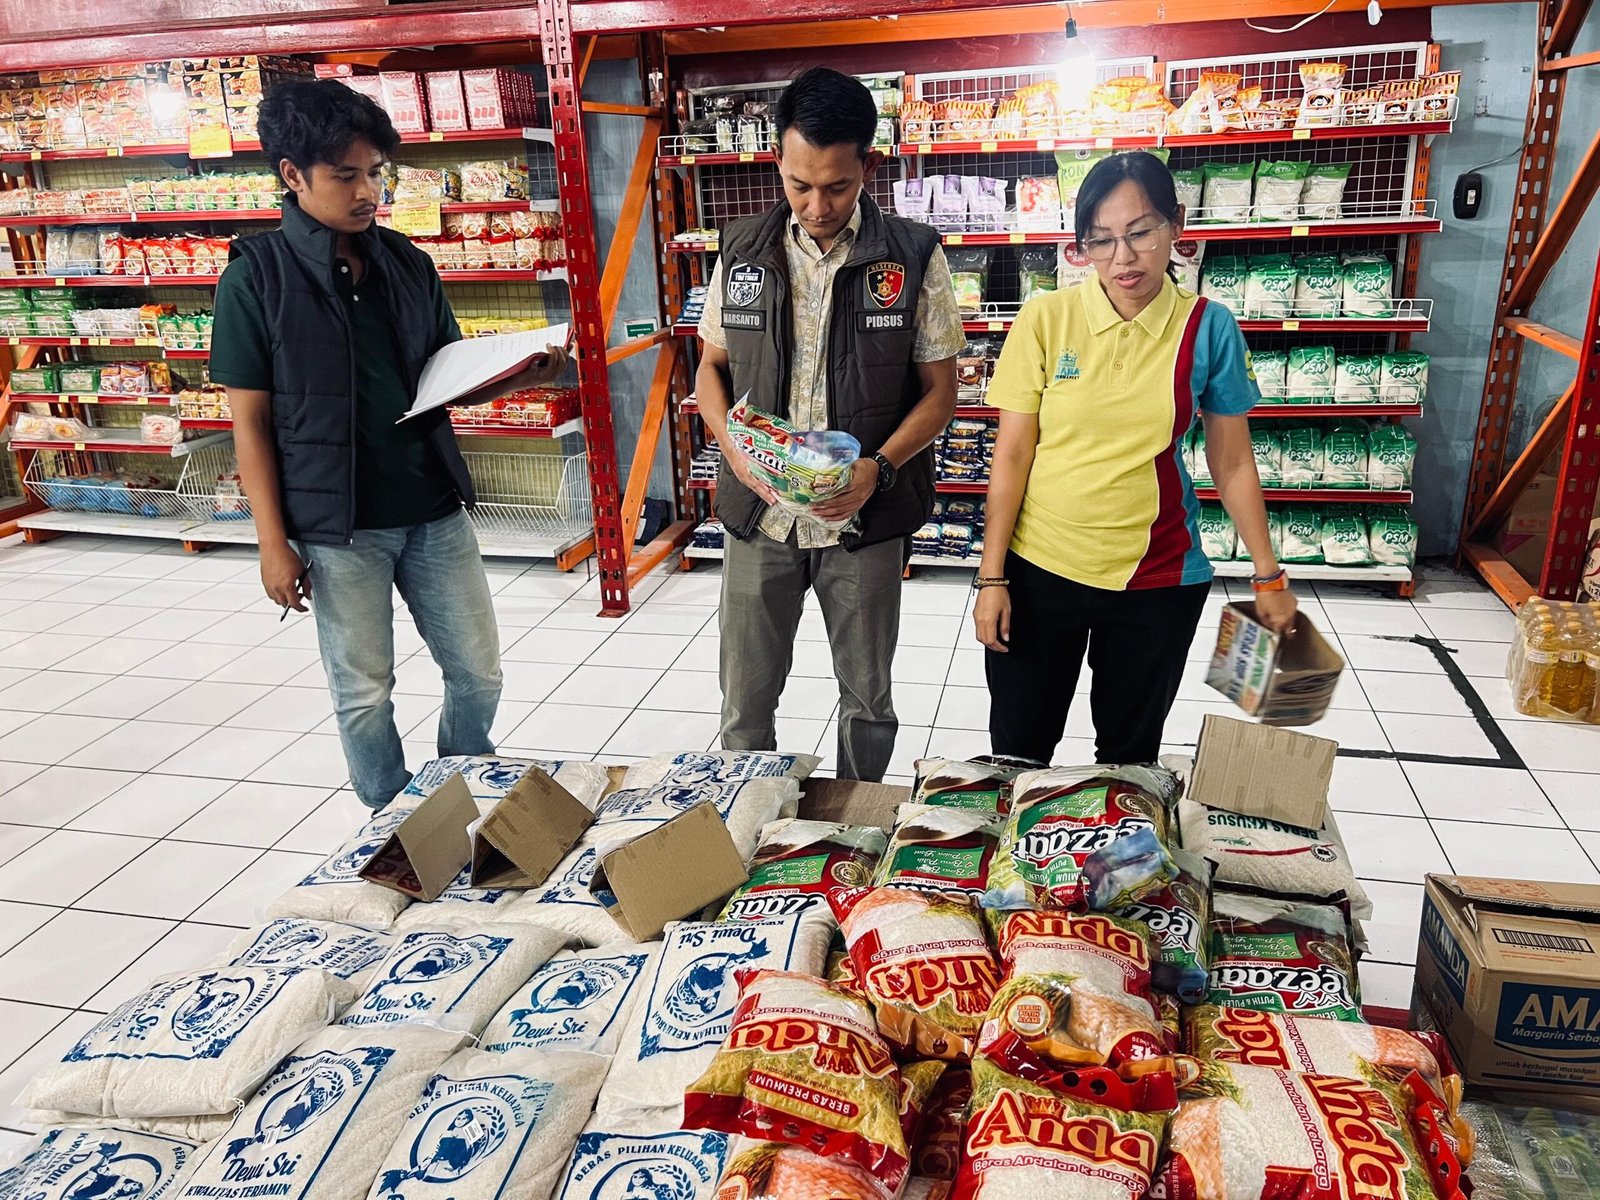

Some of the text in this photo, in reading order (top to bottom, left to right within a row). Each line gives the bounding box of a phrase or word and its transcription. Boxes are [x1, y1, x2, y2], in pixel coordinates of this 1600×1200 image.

[1212, 276, 1238, 287] PSM
[1265, 279, 1291, 291] PSM
[1309, 276, 1335, 288] PSM
[1356, 277, 1383, 292] PSM
[865, 314, 904, 328] PIDSUS
[1348, 364, 1372, 375] PSM
[1392, 366, 1419, 378] PSM
[1289, 450, 1313, 461] PSM
[1332, 453, 1356, 464] PSM
[1381, 453, 1407, 464] PSM
[1200, 522, 1224, 533] PSM
[1290, 525, 1313, 536] PSM
[1335, 530, 1360, 542] PSM
[1384, 532, 1410, 544] PSM
[1207, 813, 1268, 831] KHUSUS
[1049, 858, 1068, 873] PUTIH
[678, 926, 757, 949] Dewi Sri
[1006, 913, 1139, 960] Anda
[1424, 904, 1467, 988] AMANDA
[363, 991, 437, 1011] Dewi Sri
[1252, 996, 1275, 1005] PUTIH
[127, 1012, 160, 1041] Sri
[511, 1016, 590, 1040] Dewi Sri
[1512, 1027, 1600, 1046] Margarin Serba
[1495, 1060, 1521, 1068] untuk
[258, 1071, 296, 1098] BERAS
[755, 1075, 811, 1099] PREMIUM
[409, 1091, 442, 1120] BERAS
[489, 1084, 526, 1128] KELUARGA
[811, 1093, 851, 1114] BERAS
[976, 1091, 1150, 1169] Anda
[1281, 1079, 1331, 1190] Andalan Keluarga
[1306, 1074, 1405, 1200] Anda
[171, 1146, 187, 1171] BERAS
[221, 1151, 302, 1183] Dewi Sri
[573, 1143, 712, 1184] BERAS PILIHAN KELUARGA
[40, 1150, 94, 1187] Dewi
[974, 1156, 1012, 1173] Beras
[1014, 1155, 1078, 1174] Andalan
[1079, 1165, 1146, 1194] Keluarga
[184, 1183, 292, 1200] KWALITAS TERJAMIN
